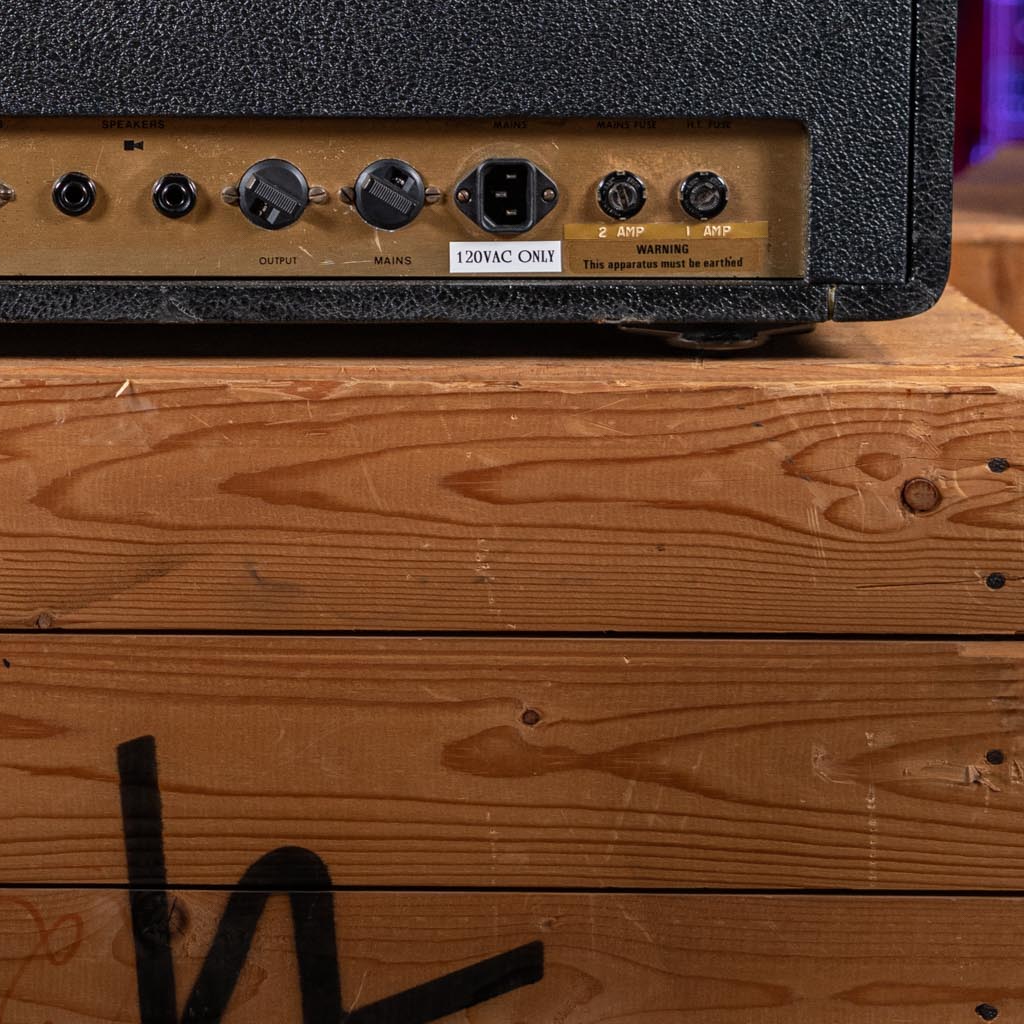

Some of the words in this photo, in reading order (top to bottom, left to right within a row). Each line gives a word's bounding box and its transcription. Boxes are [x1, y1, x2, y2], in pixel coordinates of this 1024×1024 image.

[102, 119, 165, 129] SPEAKERS
[598, 227, 607, 238] 2
[617, 226, 645, 237] AMP
[686, 227, 691, 237] 1
[703, 226, 732, 237] AMP
[636, 244, 689, 255] WARNING
[259, 256, 297, 265] OUTPUT
[374, 256, 412, 265] MAINS
[456, 250, 512, 264] 120VAC
[518, 249, 555, 263] ONLY
[583, 260, 604, 270] This
[608, 259, 658, 272] apparatus
[662, 259, 685, 269] must
[689, 258, 701, 268] be
